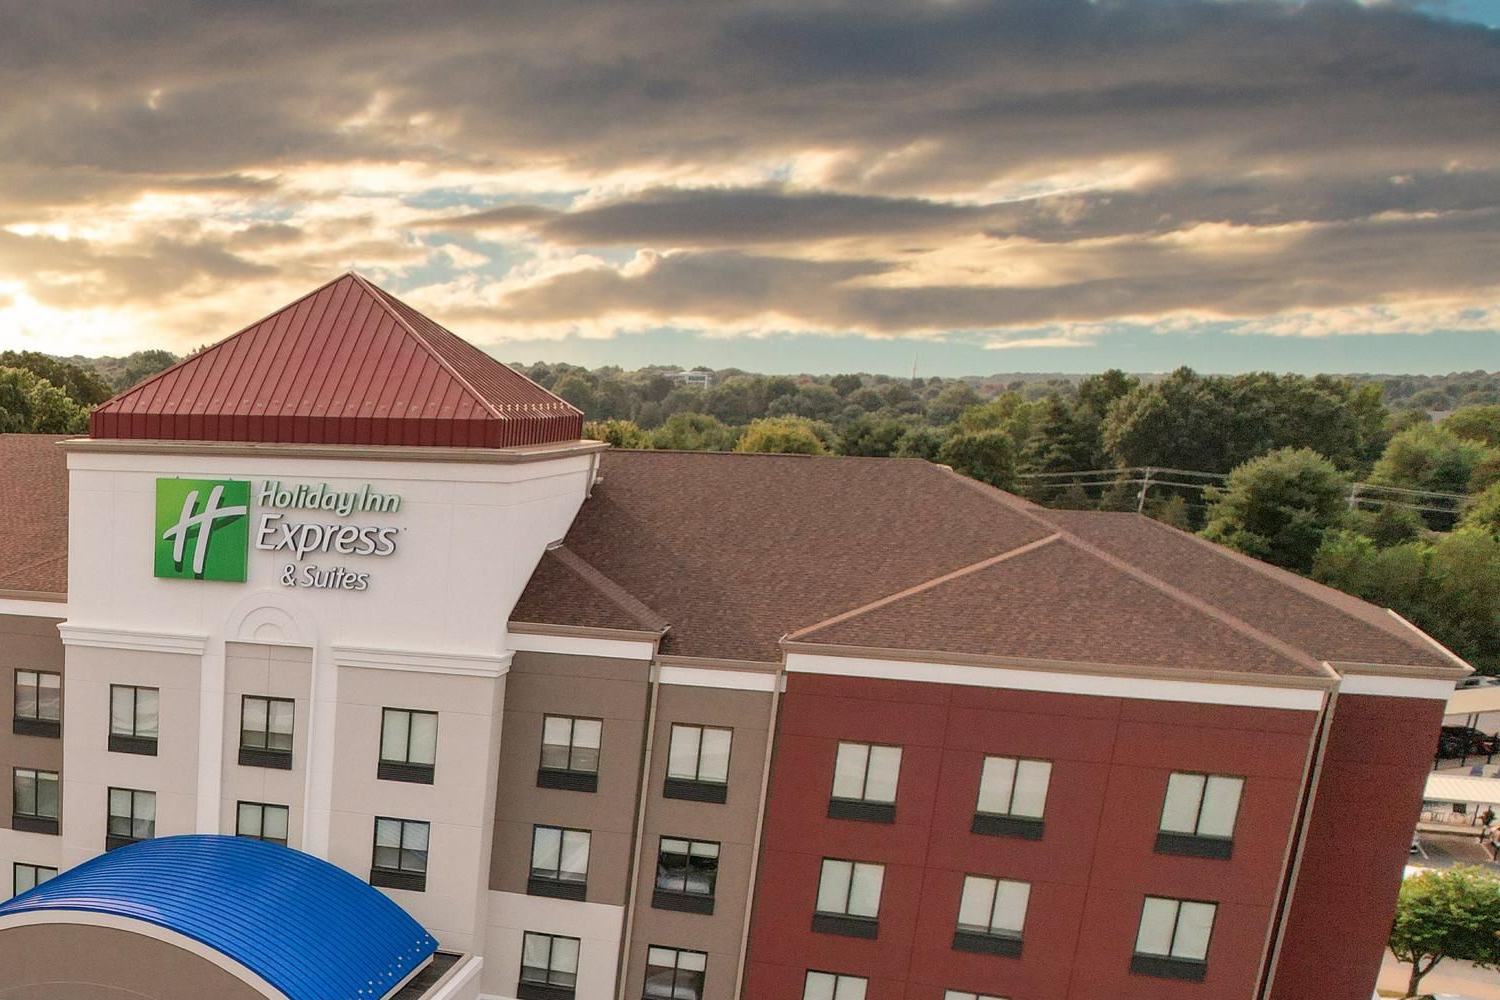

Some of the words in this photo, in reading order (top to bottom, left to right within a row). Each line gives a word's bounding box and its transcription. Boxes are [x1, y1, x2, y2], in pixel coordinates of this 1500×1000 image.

[258, 480, 357, 518] Holiday
[358, 484, 402, 512] Inn
[255, 512, 399, 561] Express
[280, 563, 297, 586] &
[300, 564, 370, 590] Suites
